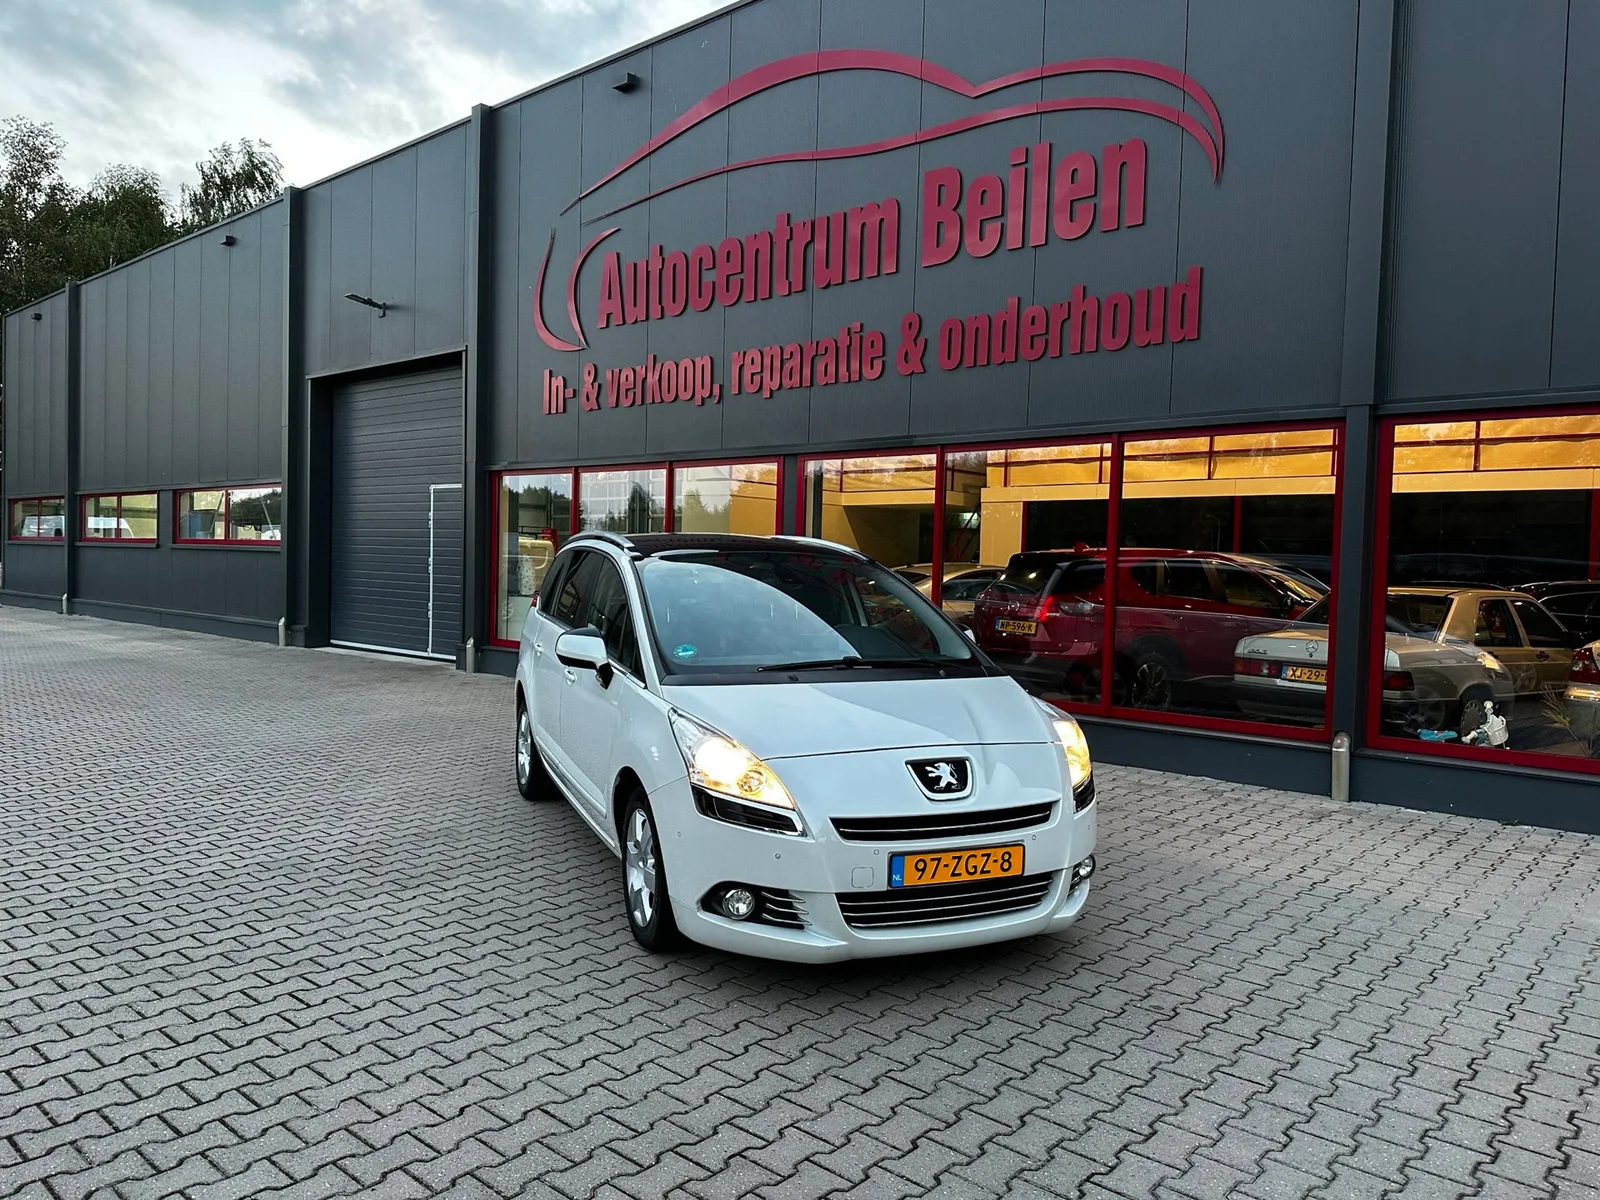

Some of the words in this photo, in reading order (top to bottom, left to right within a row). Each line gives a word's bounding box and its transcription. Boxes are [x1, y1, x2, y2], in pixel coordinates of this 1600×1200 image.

[597, 197, 900, 328] Autocentrum
[922, 137, 1147, 268] Beilen
[542, 368, 574, 415] In-
[581, 362, 600, 412] &
[606, 353, 721, 407] verkoop,
[730, 322, 884, 398] reparatie
[896, 312, 926, 376] &
[938, 266, 1204, 371] onderhoud
[1289, 667, 1327, 681] XJ-29-
[914, 851, 1012, 880] 97-ZGZ-8
